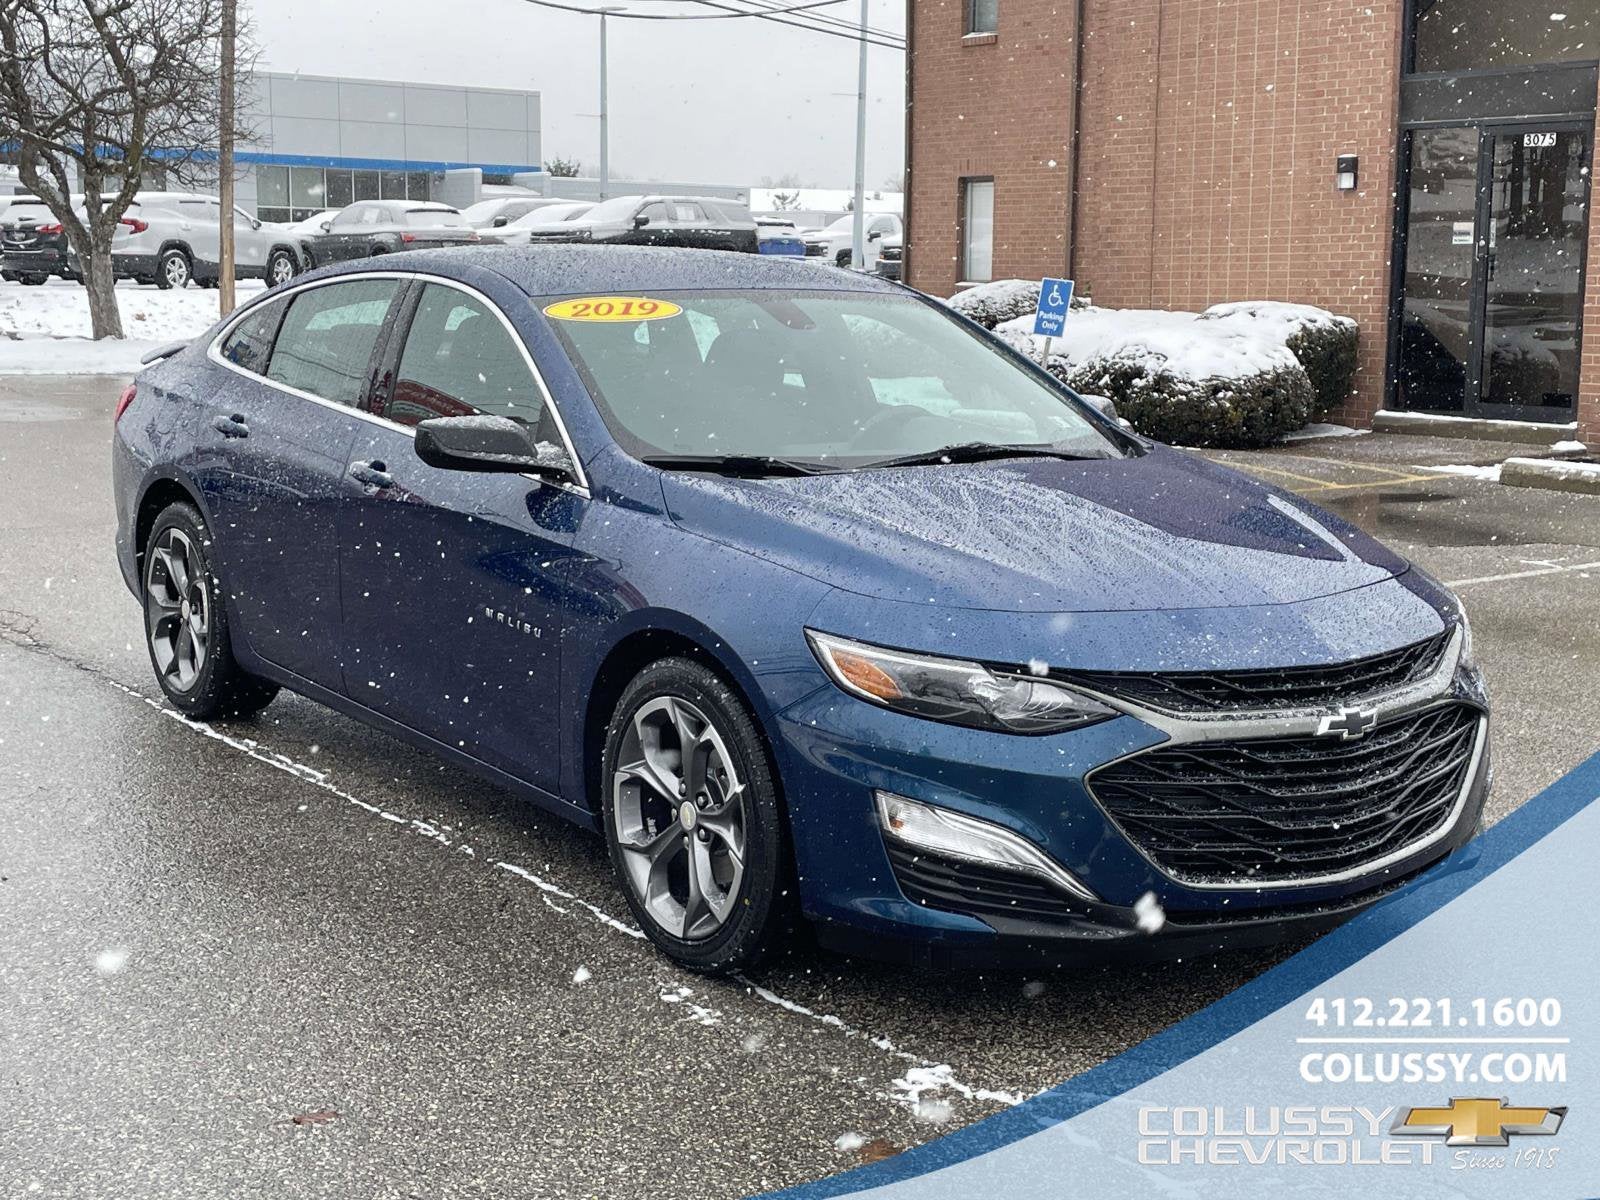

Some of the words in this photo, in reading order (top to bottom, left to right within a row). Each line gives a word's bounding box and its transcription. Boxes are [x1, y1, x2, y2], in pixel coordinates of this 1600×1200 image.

[1525, 133, 1555, 146] 3075
[571, 301, 659, 317] 2019
[1039, 310, 1064, 322] Parking
[1042, 320, 1058, 331] Only
[485, 607, 541, 638] MALIBU
